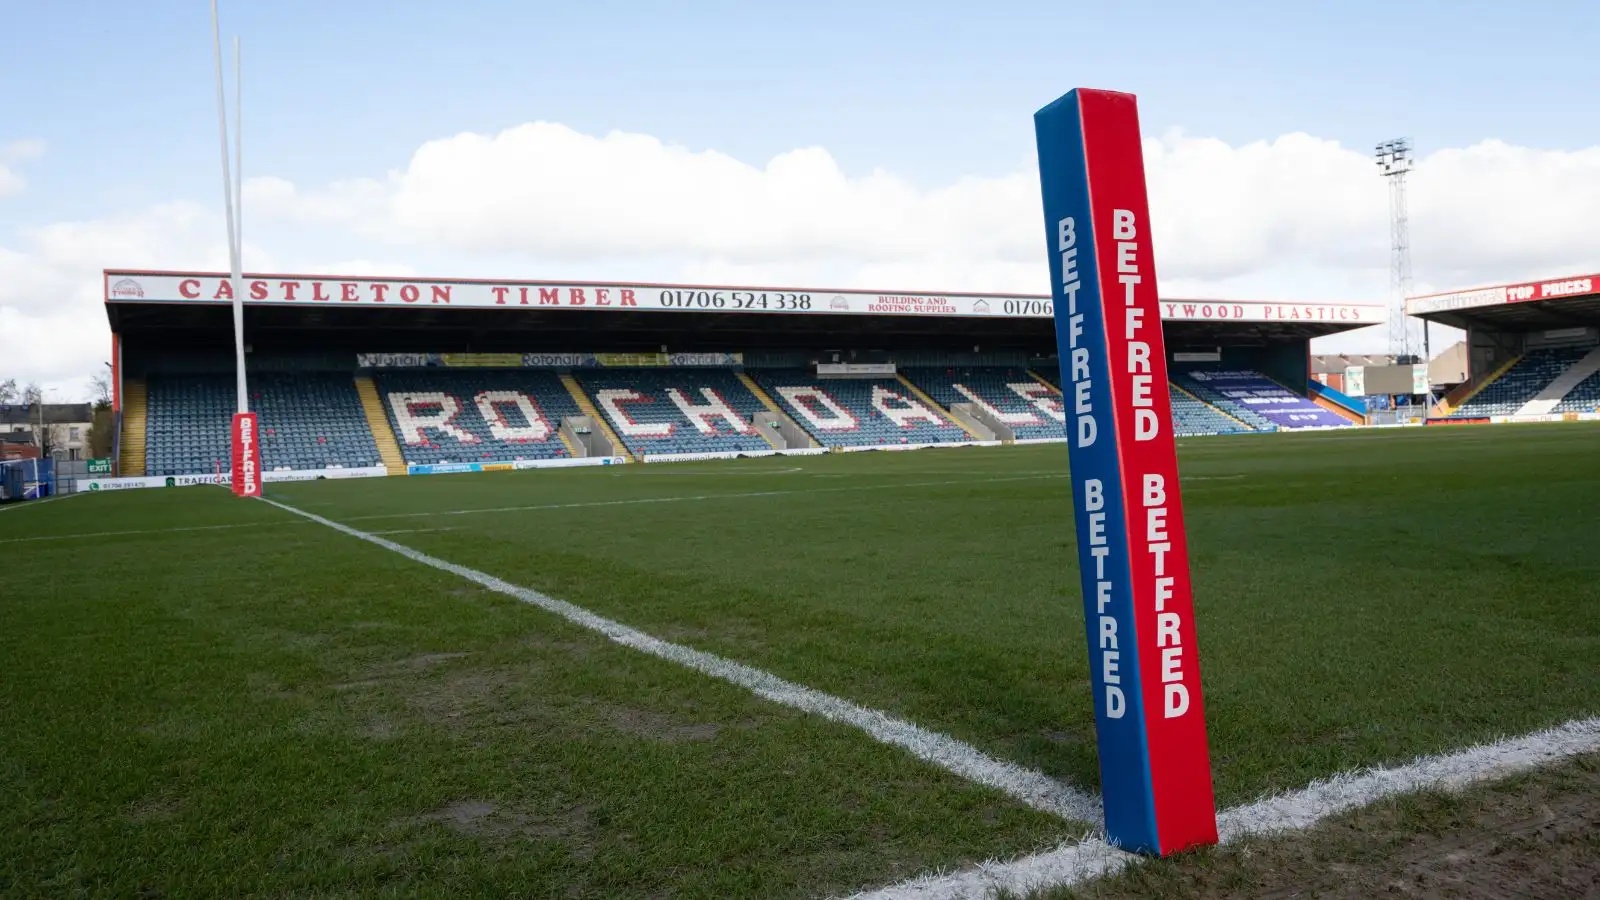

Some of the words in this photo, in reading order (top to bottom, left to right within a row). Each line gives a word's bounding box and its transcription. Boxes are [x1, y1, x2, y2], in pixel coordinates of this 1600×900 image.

[178, 279, 452, 304] CASTLETON
[491, 286, 638, 306] TIMBER
[660, 290, 726, 309] 01706
[731, 292, 768, 309] 524
[775, 293, 812, 310] 338
[878, 296, 926, 305] BUILDING
[928, 297, 947, 305] AND
[1507, 285, 1535, 301] TOP
[1541, 278, 1593, 297] PRICES
[868, 304, 911, 313] ROOFING
[914, 304, 957, 313] SUPPLIES
[1004, 300, 1052, 315] 01706
[1264, 305, 1360, 320] PLASTICS
[1058, 216, 1098, 448] BETFRED
[1113, 209, 1159, 441] BETFRED
[240, 417, 256, 494] BETFRED
[89, 464, 108, 472] EXIT
[1085, 478, 1126, 719] BETFRED
[1142, 473, 1190, 719] BETFRED
